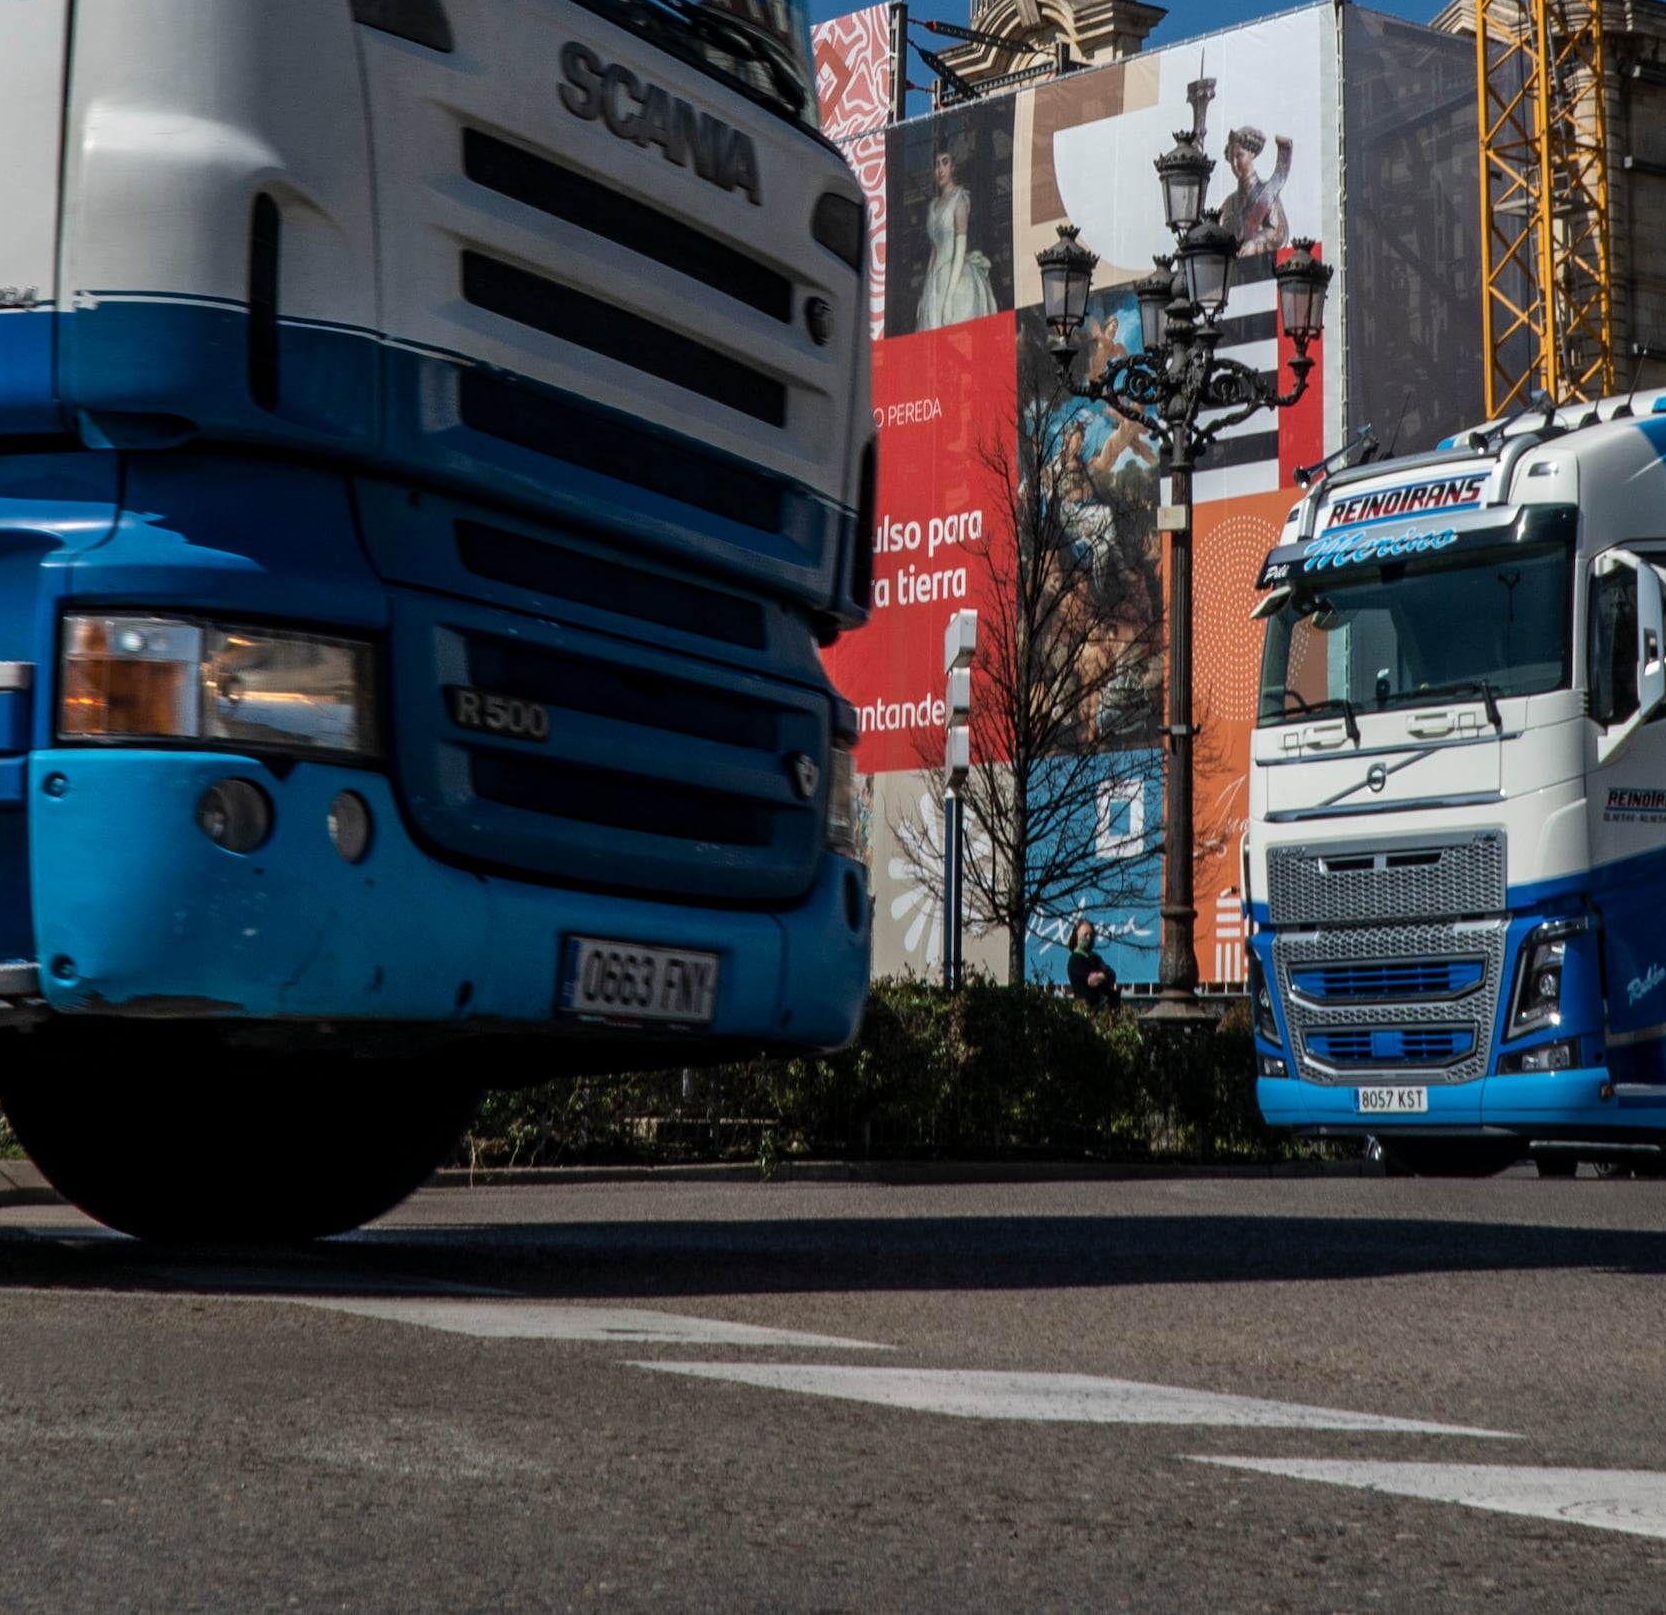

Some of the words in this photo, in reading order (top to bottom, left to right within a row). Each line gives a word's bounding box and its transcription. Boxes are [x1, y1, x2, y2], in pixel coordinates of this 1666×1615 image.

[557, 40, 764, 207] SCANIA
[888, 397, 942, 427] PEREDA
[1327, 476, 1486, 529] REINOTRANS
[928, 510, 983, 558] para
[897, 564, 966, 605] tierra
[1362, 1090, 1393, 1108] 8057
[1398, 1089, 1422, 1108] KST
